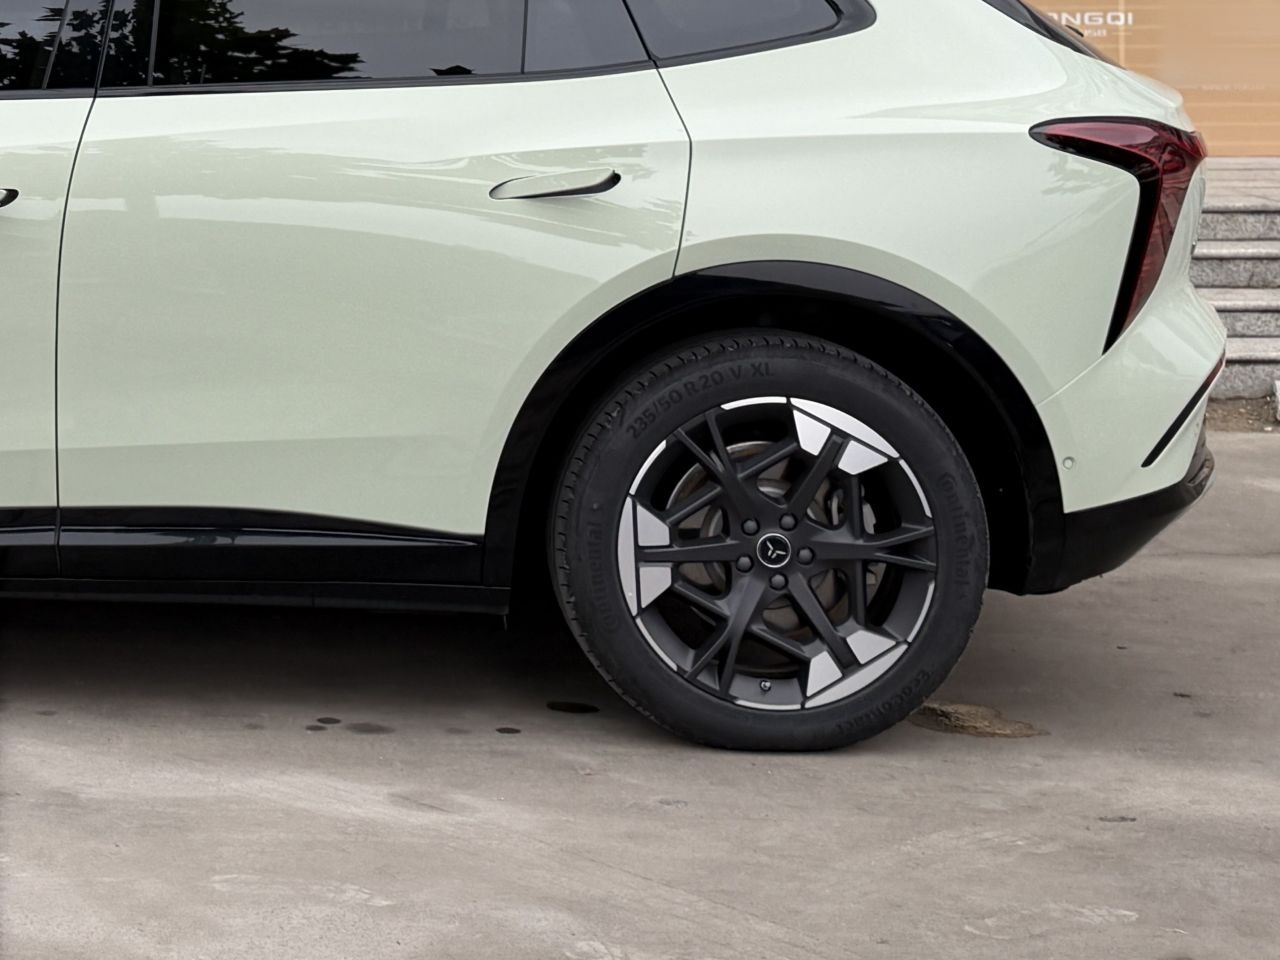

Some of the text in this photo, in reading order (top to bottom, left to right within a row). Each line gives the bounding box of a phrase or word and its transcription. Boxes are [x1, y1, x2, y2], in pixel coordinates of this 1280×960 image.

[625, 389, 683, 439] 235/50
[729, 365, 743, 380] V
[750, 361, 775, 378] XL
